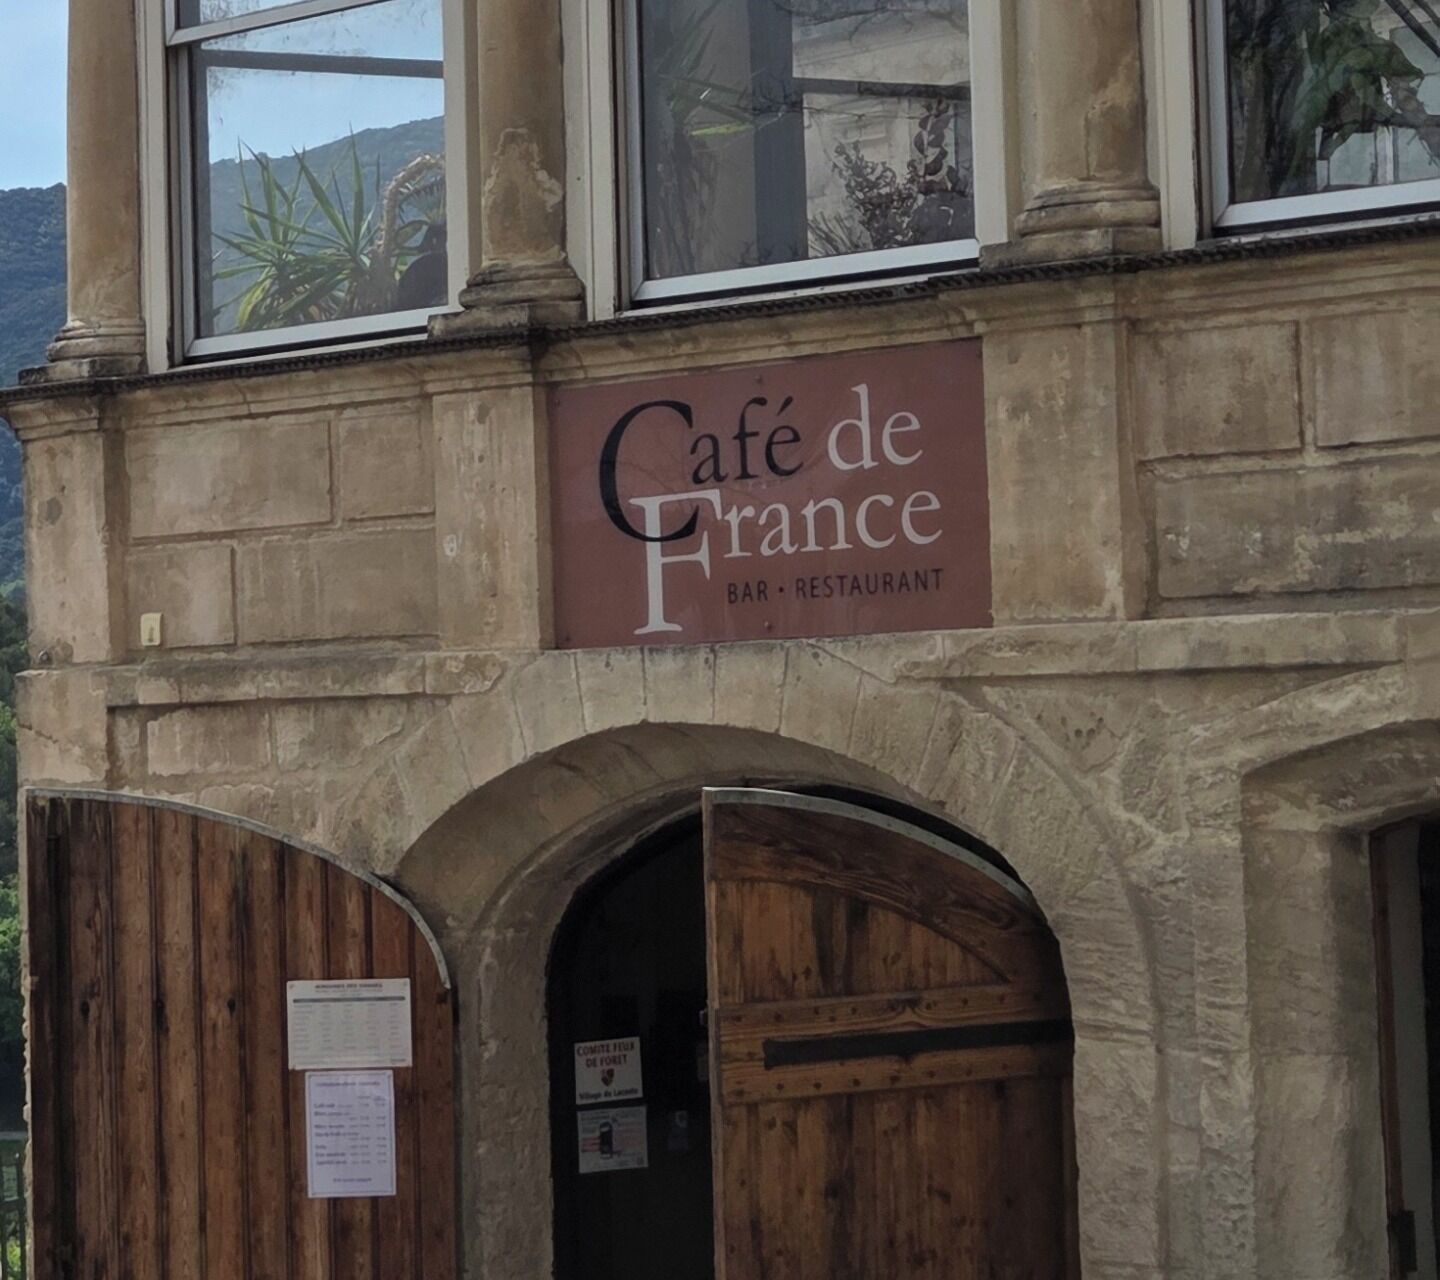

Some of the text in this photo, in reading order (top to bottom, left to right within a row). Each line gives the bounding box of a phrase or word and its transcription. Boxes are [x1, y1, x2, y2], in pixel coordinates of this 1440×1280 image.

[599, 384, 922, 542] Café de
[628, 489, 943, 634] France
[727, 568, 944, 604] BAR RESTAURANT
